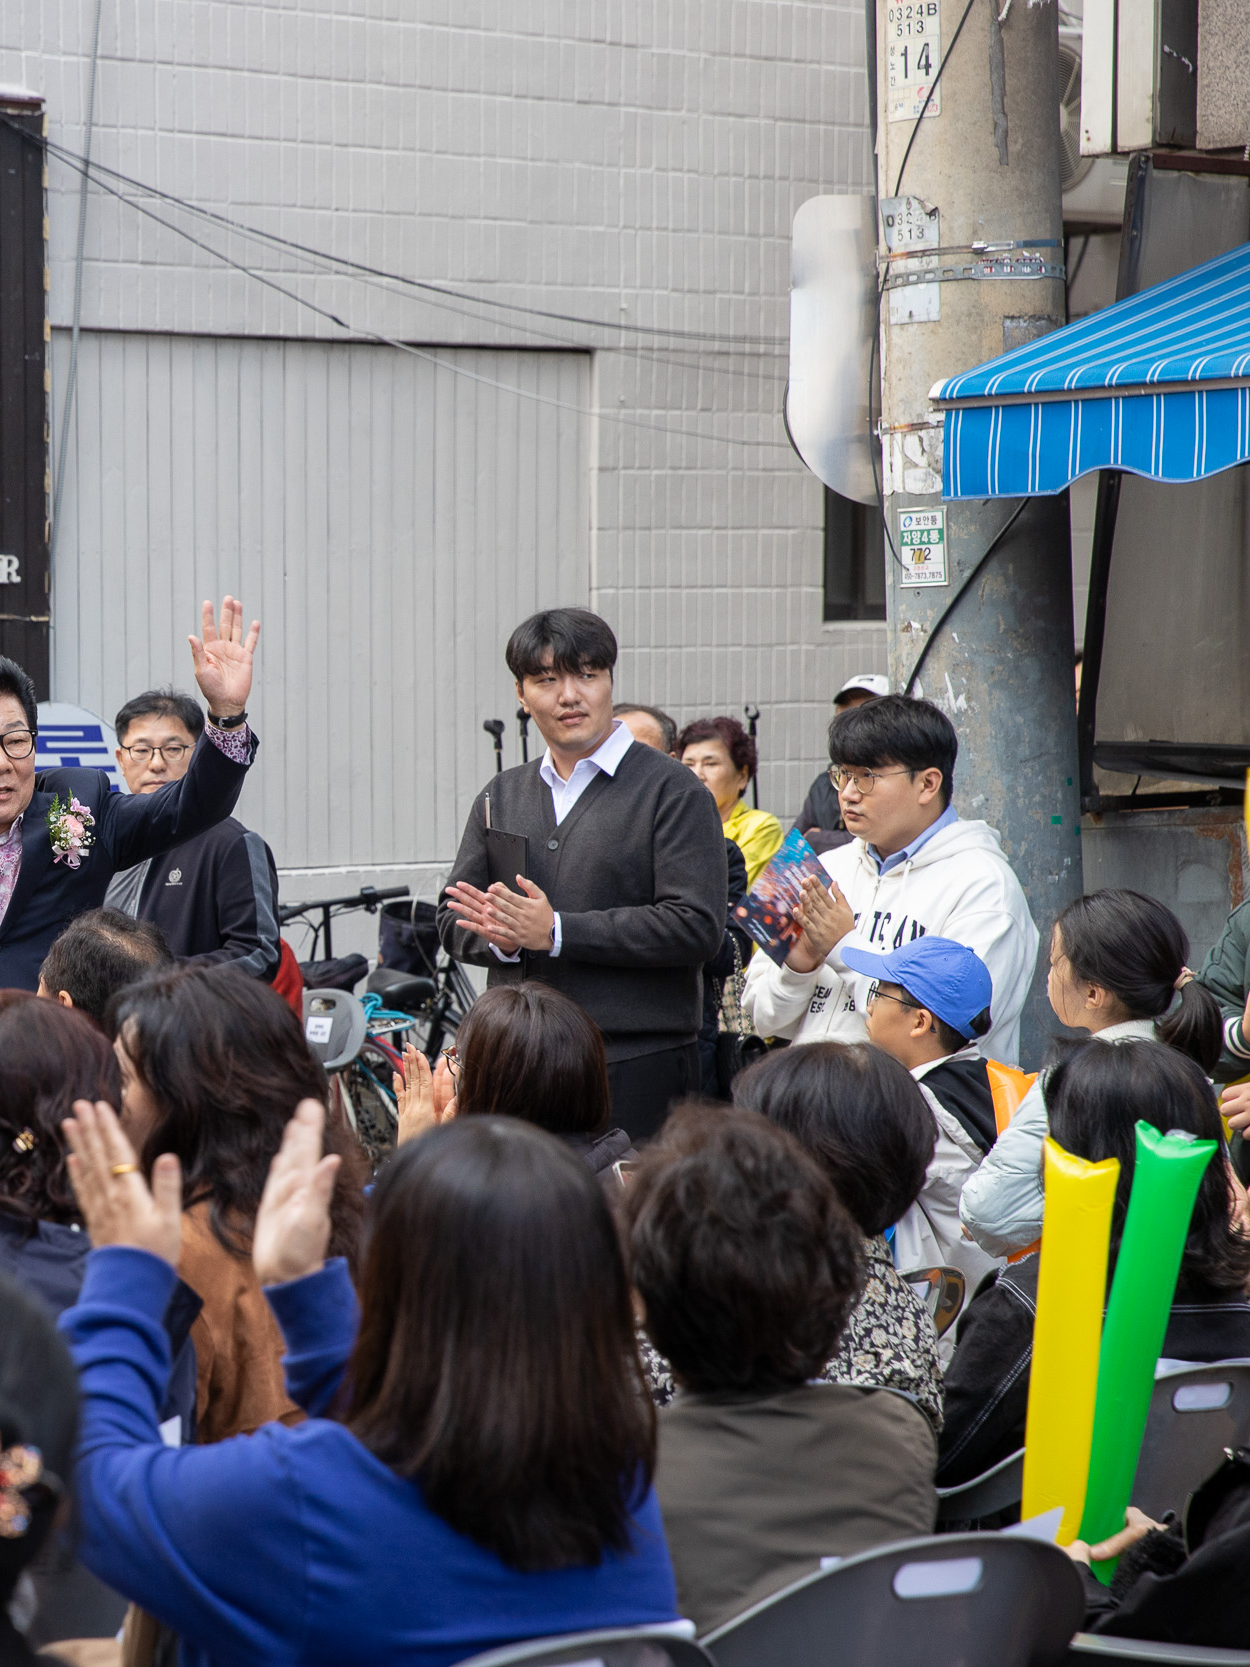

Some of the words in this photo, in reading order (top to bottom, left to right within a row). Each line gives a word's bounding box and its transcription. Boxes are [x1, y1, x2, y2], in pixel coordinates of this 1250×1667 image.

[888, 3, 938, 22] 0324B
[896, 20, 924, 37] 513
[900, 42, 932, 79] 14
[915, 515, 937, 526] 보안등
[910, 547, 931, 561] 772
